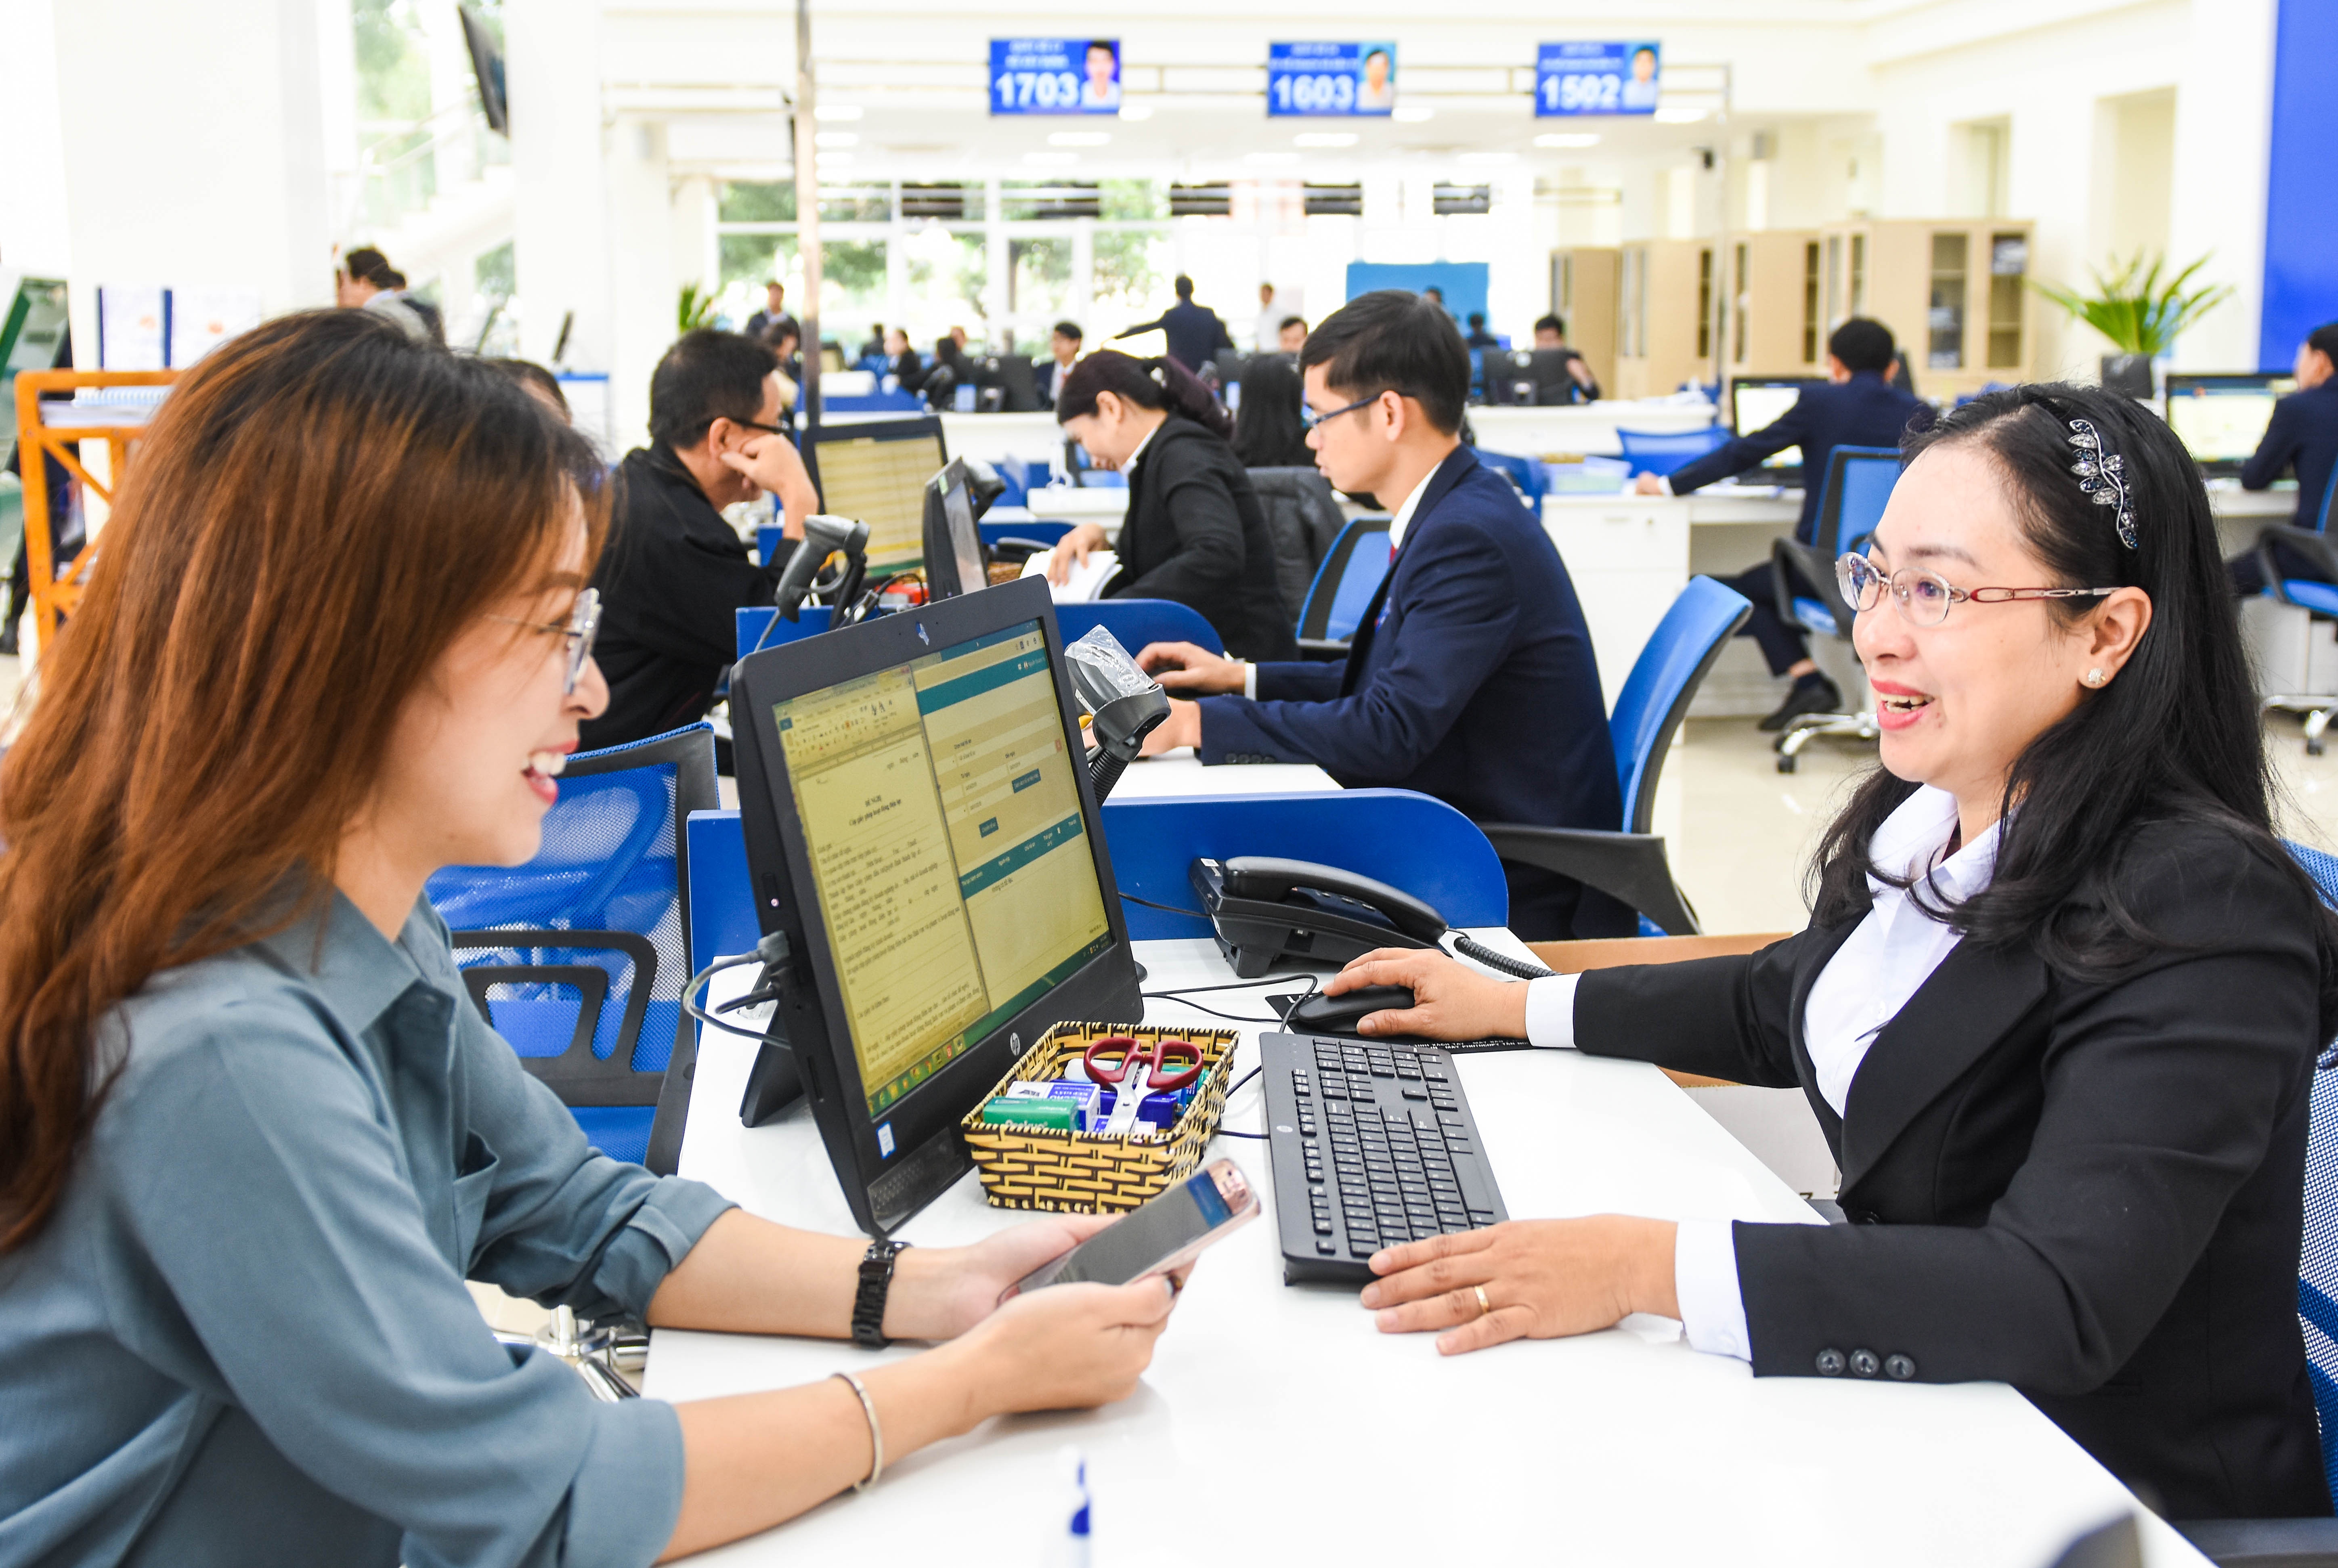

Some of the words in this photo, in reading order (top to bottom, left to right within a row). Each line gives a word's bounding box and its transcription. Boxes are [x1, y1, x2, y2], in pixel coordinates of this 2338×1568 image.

[995, 71, 1079, 109] 1703
[1274, 74, 1354, 110] 1603
[1541, 74, 1621, 110] 1502
[1010, 1032, 1020, 1056] hp
